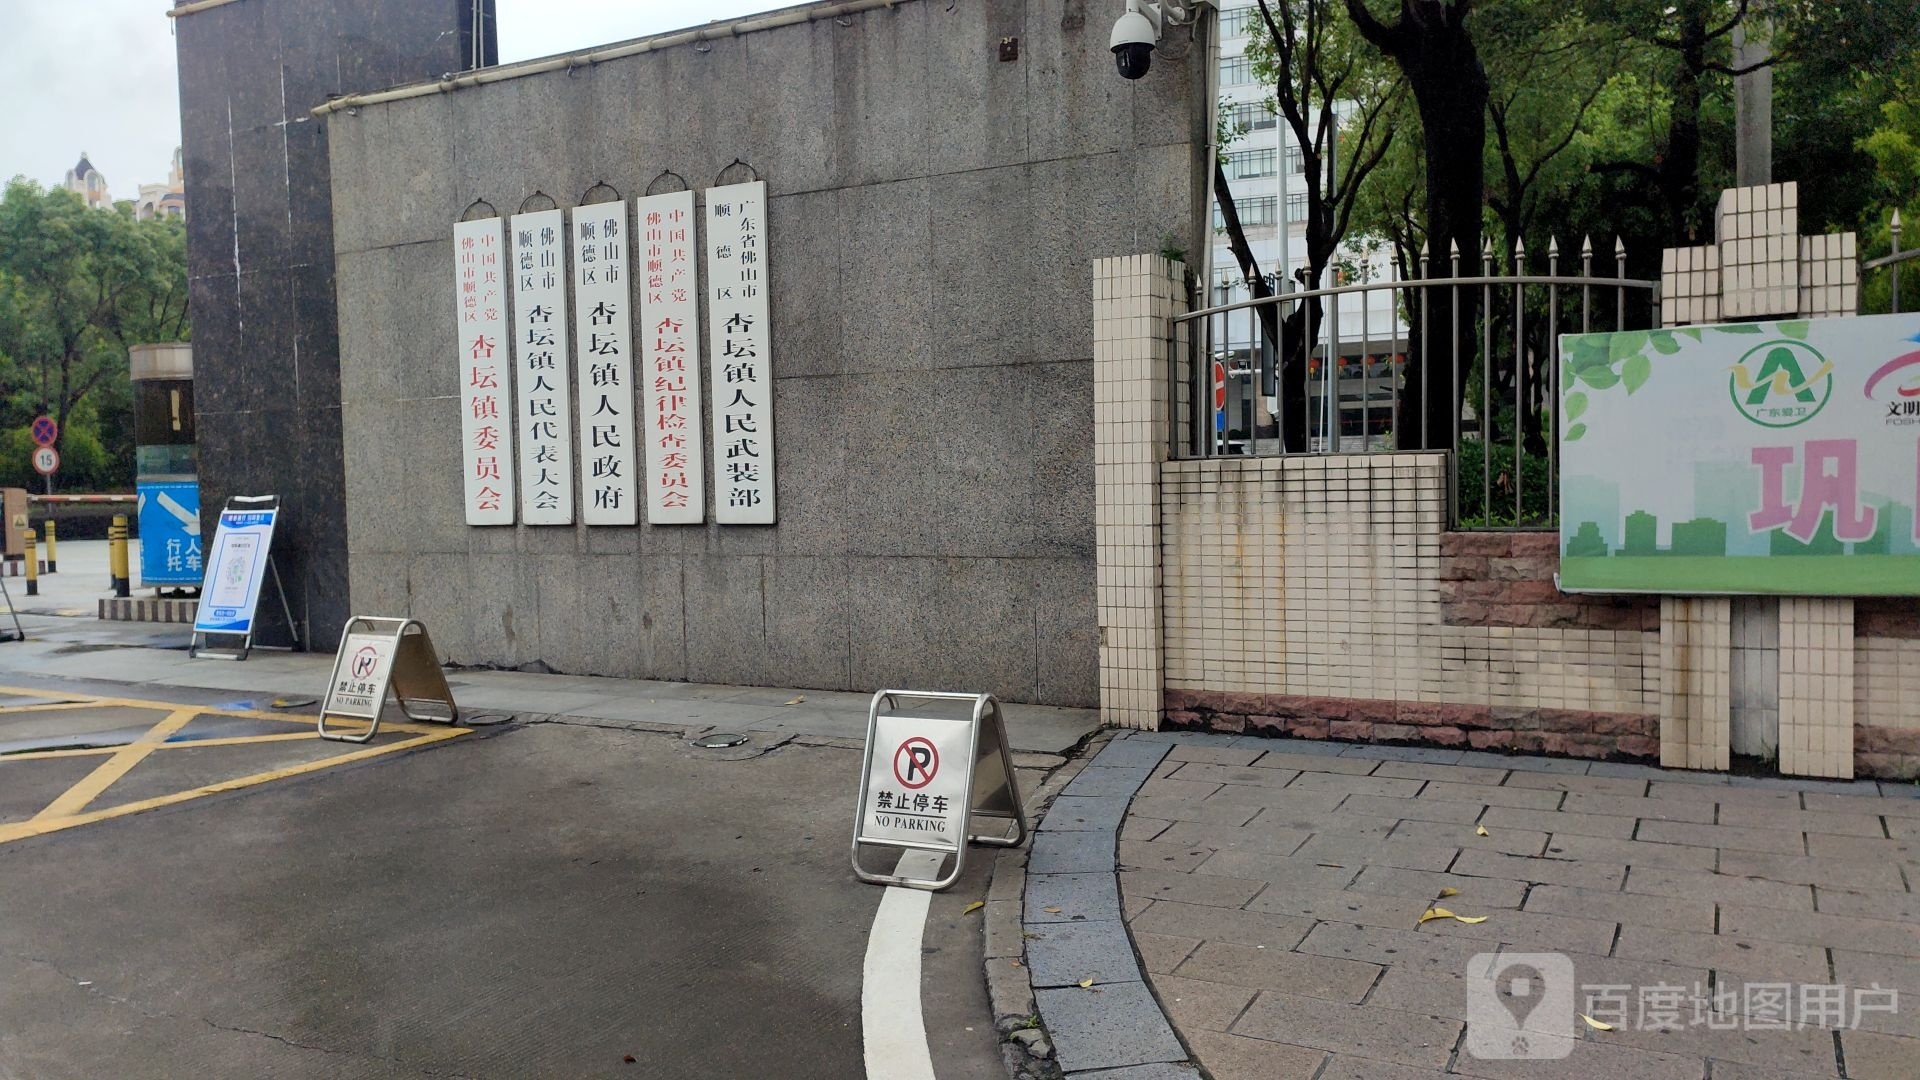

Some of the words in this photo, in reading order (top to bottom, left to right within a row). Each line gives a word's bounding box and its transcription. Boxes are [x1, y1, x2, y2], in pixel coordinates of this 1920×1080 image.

[461, 237, 477, 323] 佛山市顺德区
[481, 235, 498, 321] 中国共产党
[518, 230, 534, 292] 顺德区
[541, 227, 555, 290] 佛山市
[580, 221, 597, 286] 顺德区
[603, 218, 619, 283] 佛山市
[646, 211, 664, 304] 佛山市顺德区
[669, 209, 687, 302] 中国共产党
[714, 202, 733, 300] 顺德区
[739, 200, 757, 298] 广东省佛山市
[470, 334, 502, 511] 杏坛镇委员会
[526, 304, 560, 510] 杏坛镇人民代表大会
[586, 301, 624, 510] 杏坛镇人民政府
[654, 317, 690, 508] 杏坛镇纪律检查委员会
[722, 313, 761, 508] 杏坛镇人民武装部
[40, 454, 53, 466] 15
[1750, 438, 1920, 543] 巩
[338, 681, 377, 695] 禁止停车
[345, 697, 373, 707] PARKING
[874, 815, 890, 827] NO
[894, 817, 946, 833] PARKING
[877, 790, 949, 814] 禁止停车
